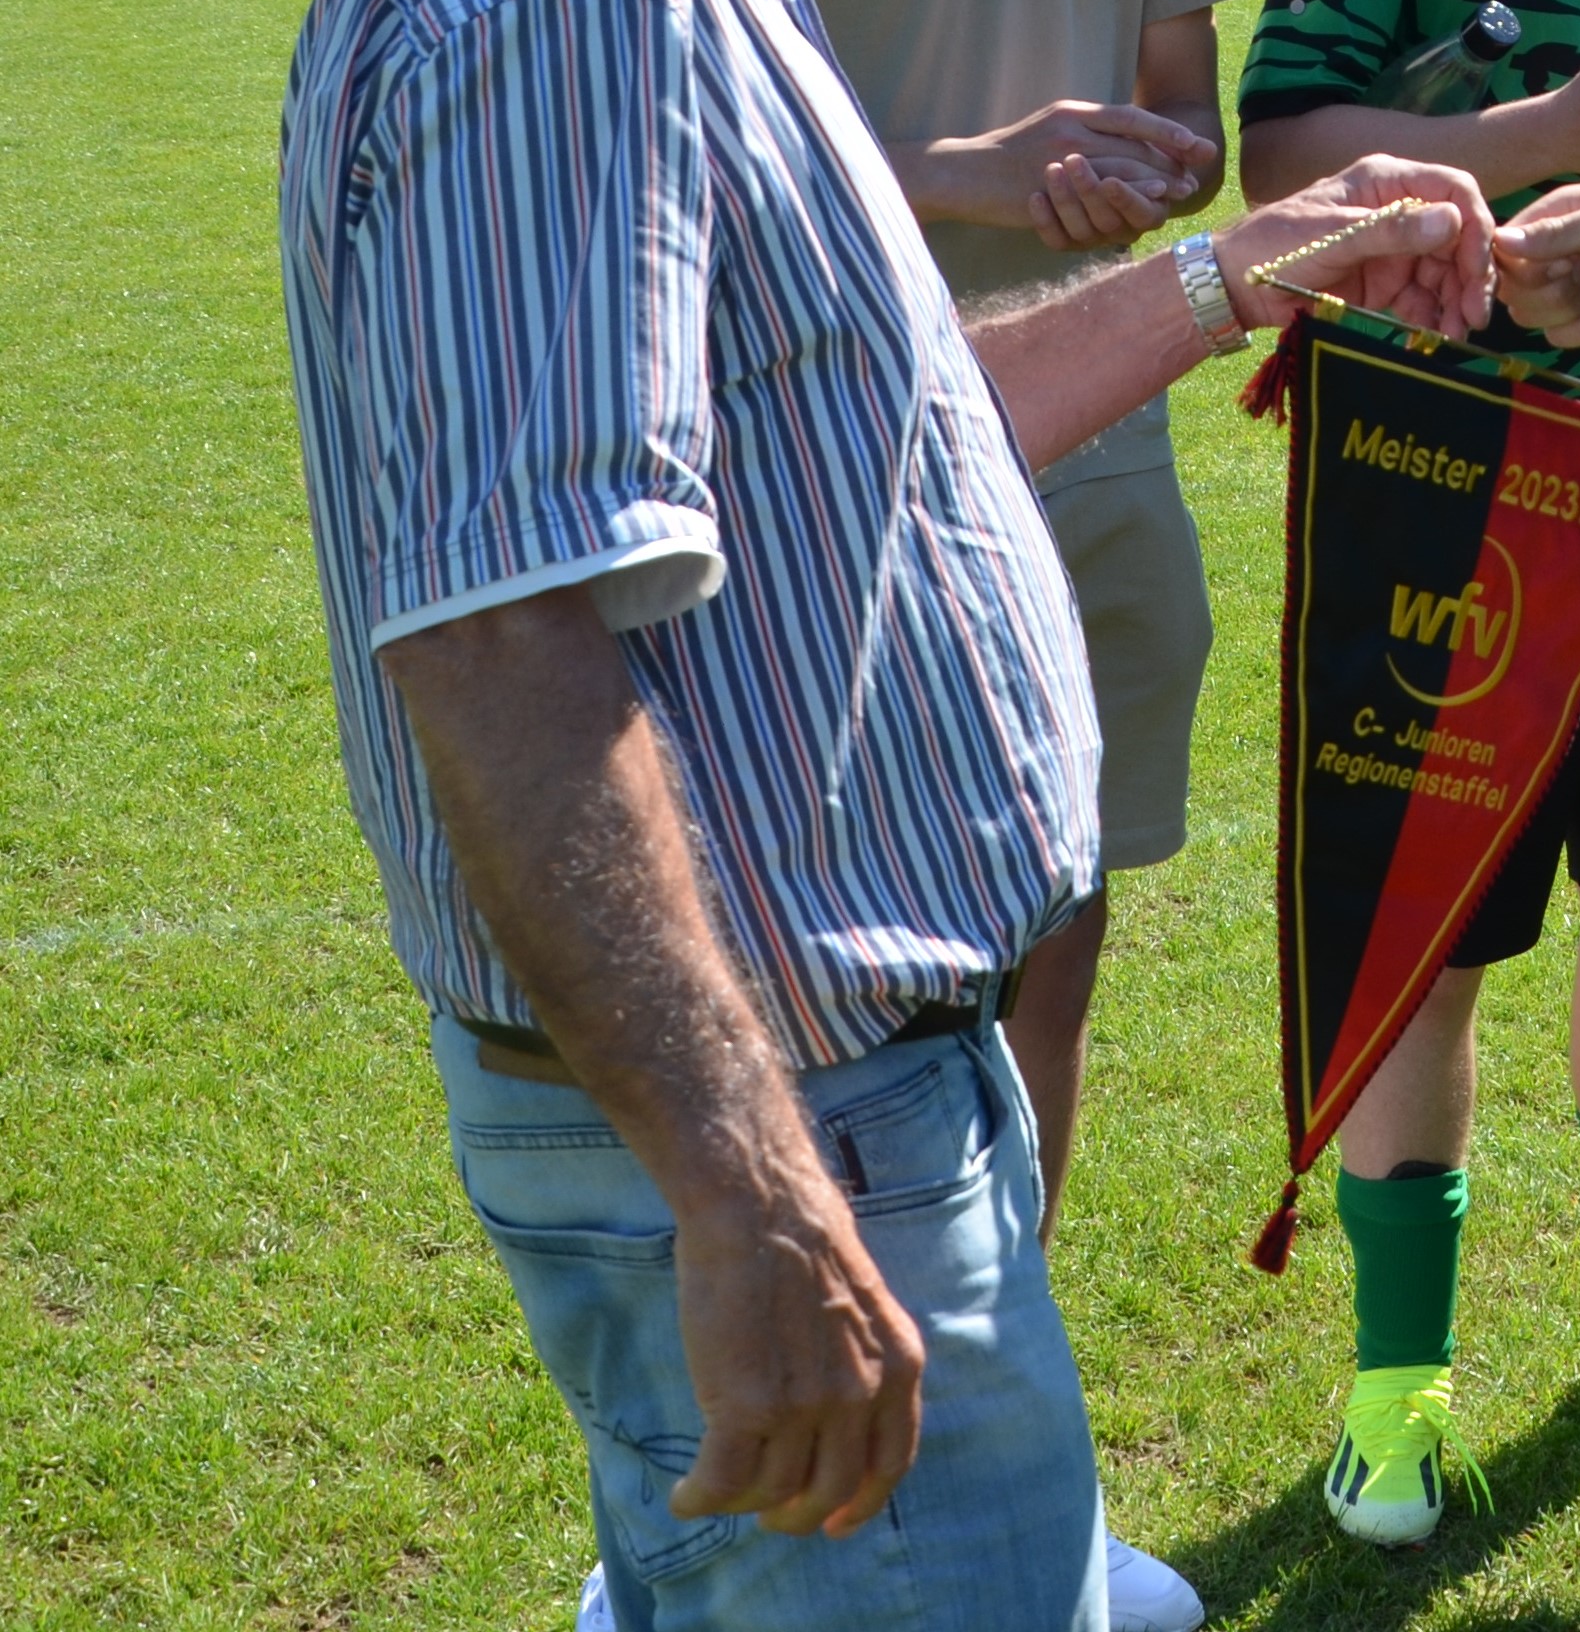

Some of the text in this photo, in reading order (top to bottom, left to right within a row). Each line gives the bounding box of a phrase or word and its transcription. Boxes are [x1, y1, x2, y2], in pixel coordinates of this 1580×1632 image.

[1342, 419, 1486, 493] Meister
[1389, 581, 1508, 659] wfv
[1353, 707, 1496, 766] C- Junioren
[1315, 742, 1509, 811] Regionenstaffel
